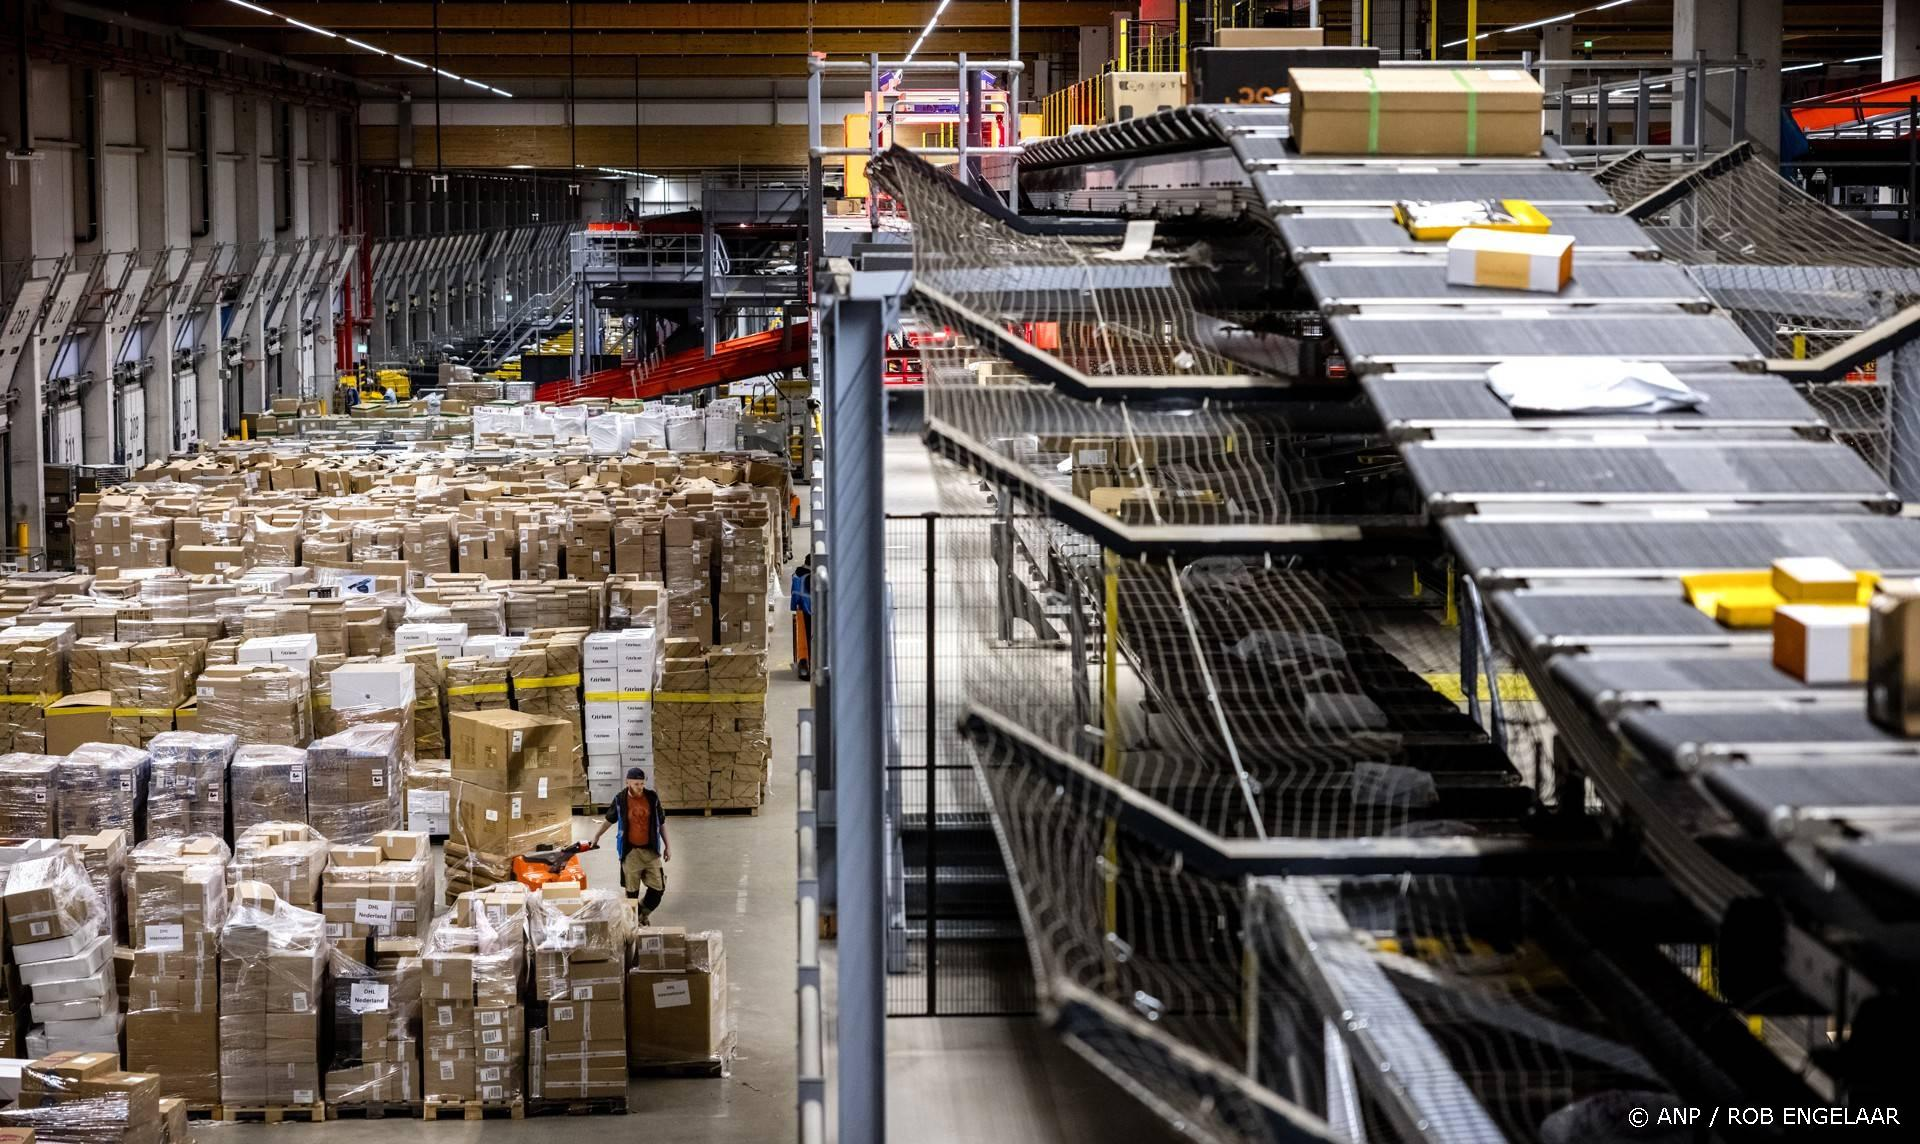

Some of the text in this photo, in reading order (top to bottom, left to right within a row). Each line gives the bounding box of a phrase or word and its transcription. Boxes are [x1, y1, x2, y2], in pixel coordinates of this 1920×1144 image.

[9, 308, 30, 335] 213
[52, 300, 71, 325] 212
[354, 996, 385, 1004] Nederland
